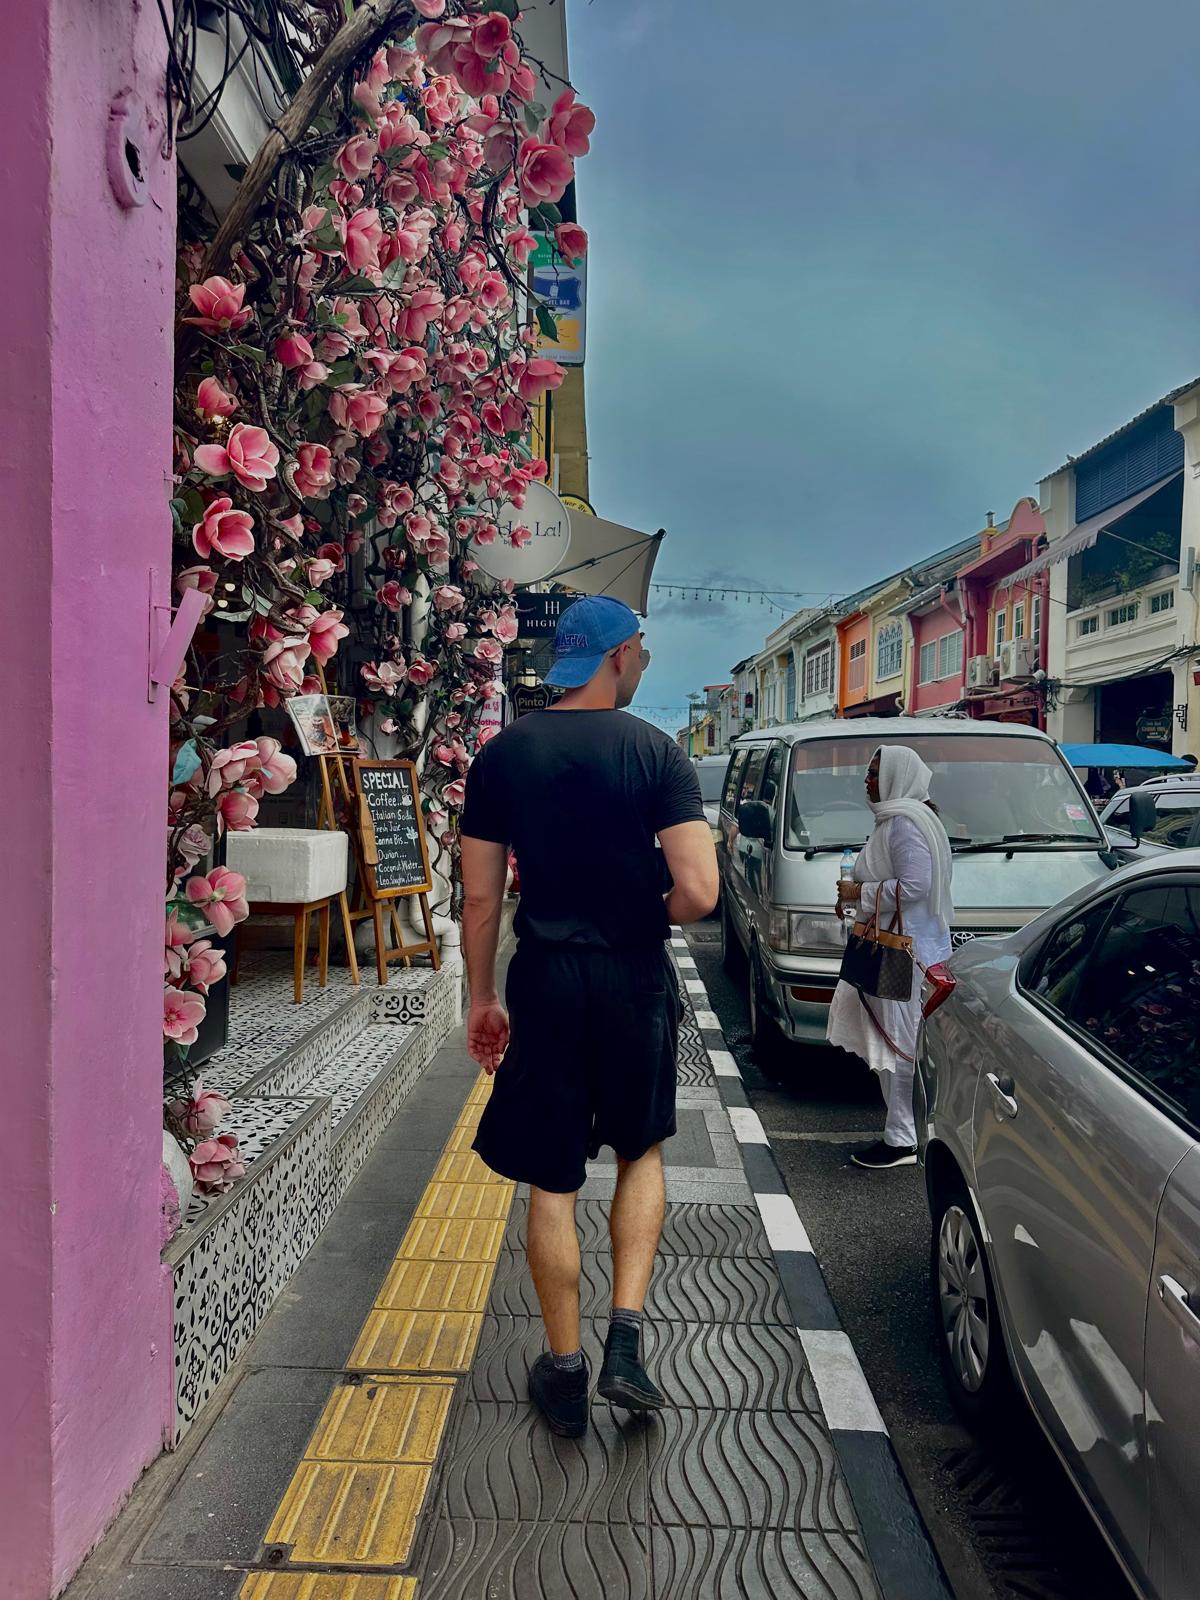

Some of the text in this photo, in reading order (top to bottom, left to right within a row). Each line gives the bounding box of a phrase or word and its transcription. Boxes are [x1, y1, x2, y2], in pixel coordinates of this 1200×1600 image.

[536, 521, 561, 537] La!
[518, 698, 544, 706] Pinto
[363, 772, 408, 789] SPECIAL
